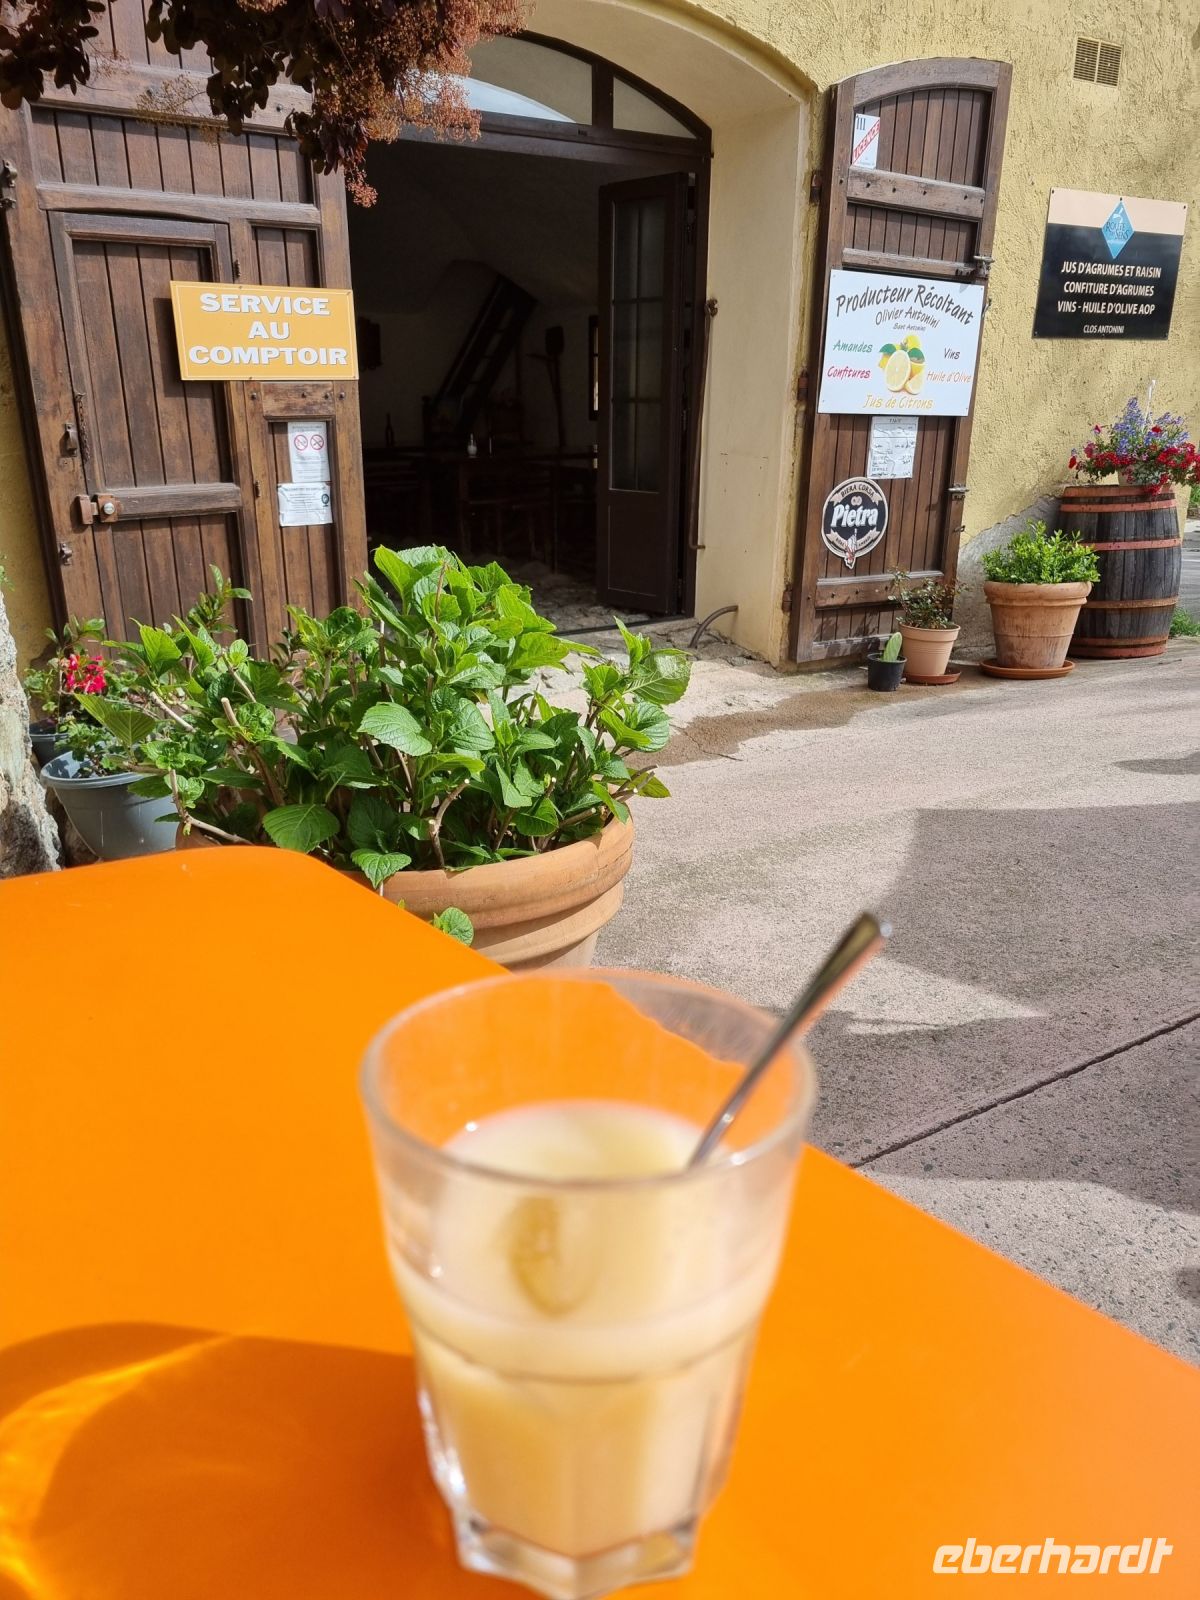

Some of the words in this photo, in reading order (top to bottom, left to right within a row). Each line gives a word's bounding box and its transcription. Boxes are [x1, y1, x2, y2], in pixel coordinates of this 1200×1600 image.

[1061, 262, 1077, 273] JUS
[1078, 262, 1124, 276] D'AGRUMES
[1124, 265, 1135, 277] ET
[1135, 266, 1162, 278] RAISIN
[1063, 281, 1108, 295] CONFITURE
[1109, 284, 1155, 297] D'AGRUMES
[200, 293, 331, 316] SERVICE
[836, 285, 914, 318] Producteur
[915, 284, 974, 326] Récoltant
[1057, 301, 1077, 313] VINS
[1082, 302, 1106, 314] HUILE
[1107, 303, 1138, 314] D'OLIVE
[1139, 304, 1155, 315] AOP
[875, 308, 903, 326] Olivier
[904, 306, 941, 329] Antonini
[248, 321, 291, 340] AU
[1083, 324, 1098, 334] CLOS
[1097, 325, 1125, 334] ANTONINI
[832, 340, 874, 353] Amandes
[943, 347, 961, 360] Vins
[188, 345, 348, 366] COMPTOIR
[827, 365, 872, 380] Confitures
[926, 370, 946, 382] Huile
[946, 371, 972, 384] d'Olive
[863, 395, 883, 409] Jus
[886, 398, 897, 408] de
[898, 398, 934, 410] Citrons
[841, 484, 858, 498] BIERA
[858, 483, 875, 497] CORSA
[830, 504, 879, 528] Pietra
